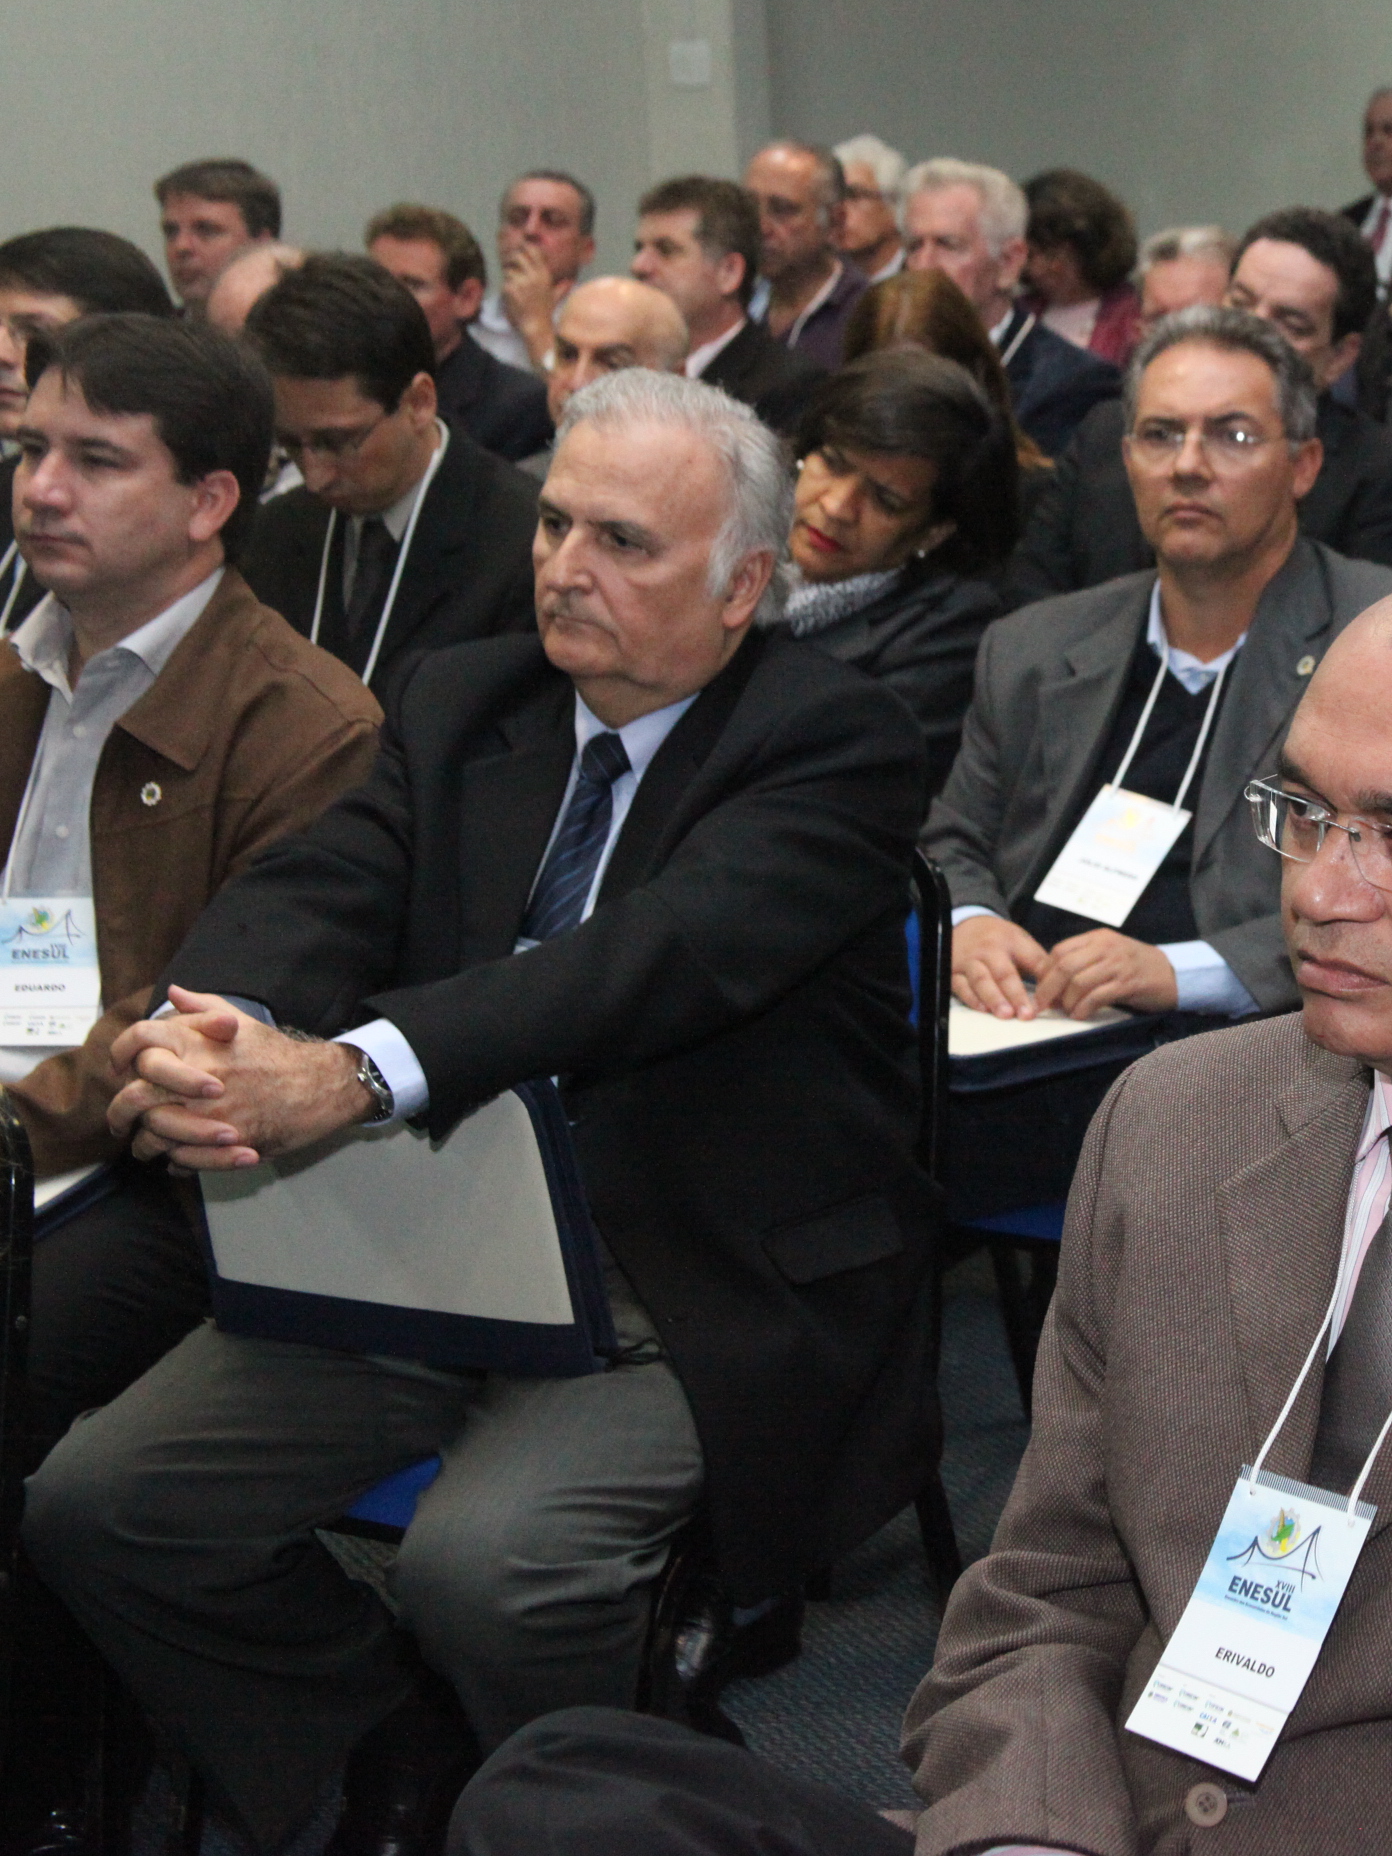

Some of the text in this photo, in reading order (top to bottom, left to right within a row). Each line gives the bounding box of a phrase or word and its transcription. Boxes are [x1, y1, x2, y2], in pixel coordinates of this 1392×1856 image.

[11, 948, 70, 959] ENESUL
[14, 983, 66, 992] EDUARDO
[1228, 1575, 1292, 1613] ENESUL
[1275, 1579, 1296, 1594] XVIII
[1215, 1646, 1276, 1678] ERIVALDO
